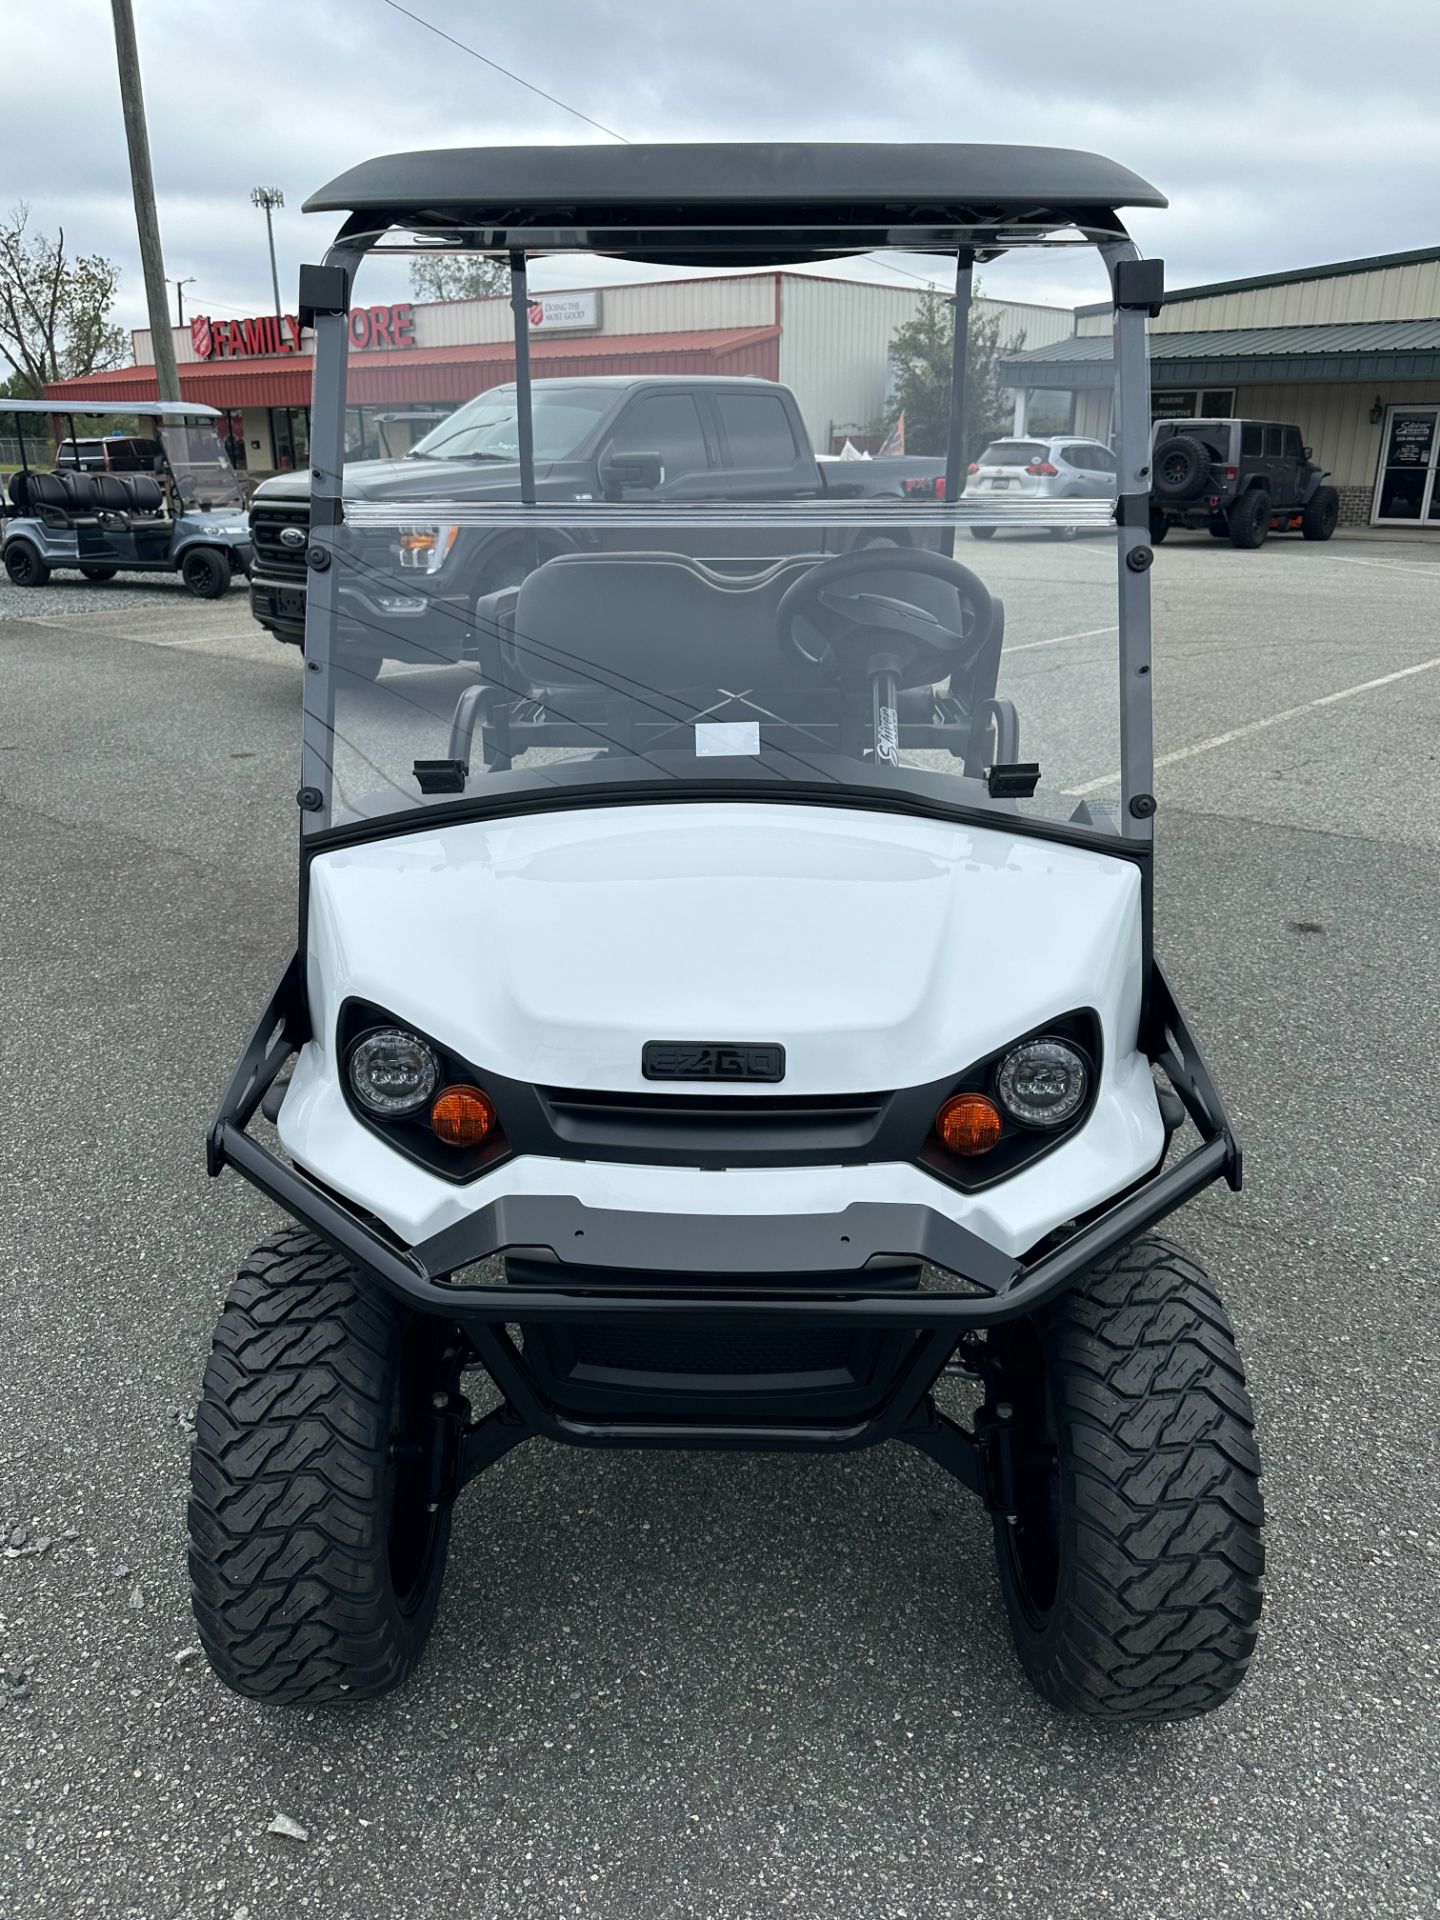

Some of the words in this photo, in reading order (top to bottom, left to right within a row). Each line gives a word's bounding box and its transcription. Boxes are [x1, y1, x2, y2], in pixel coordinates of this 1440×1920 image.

[545, 303, 567, 312] DOING
[568, 302, 580, 310] THE
[545, 312, 562, 320] MOST
[564, 311, 585, 320] GOOD
[212, 314, 302, 356] FAMILY
[350, 303, 414, 348] ORE
